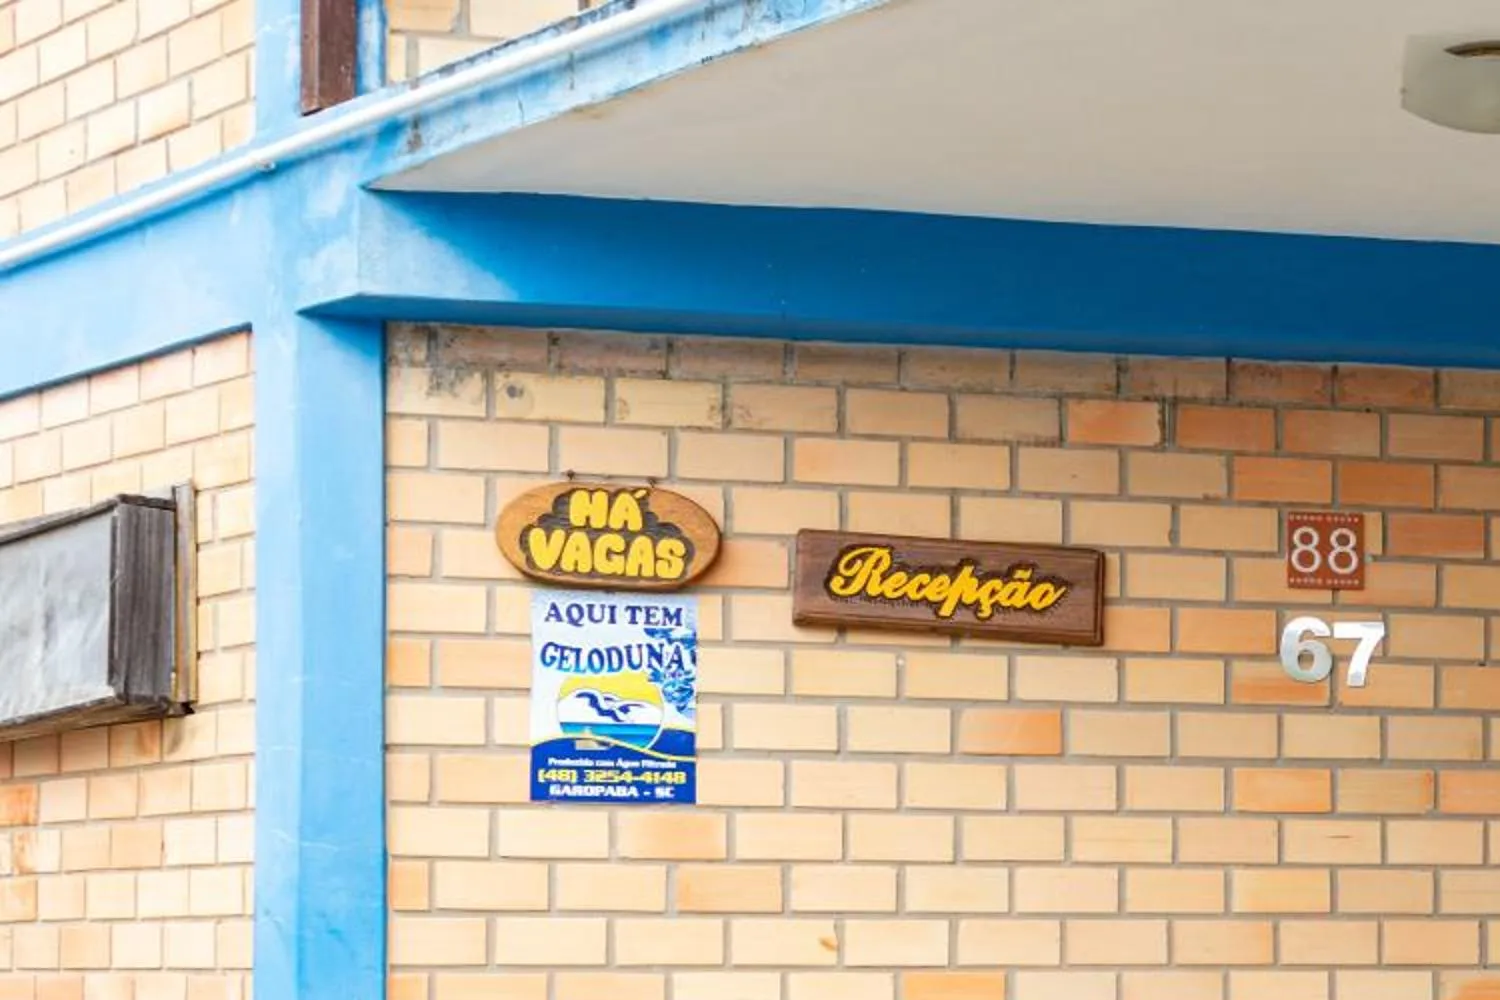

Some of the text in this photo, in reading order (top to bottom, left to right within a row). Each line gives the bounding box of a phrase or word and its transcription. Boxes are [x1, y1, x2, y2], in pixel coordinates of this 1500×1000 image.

[569, 488, 649, 532] HÁ
[528, 528, 687, 579] VAGAS
[1291, 526, 1359, 574] 88
[830, 546, 1069, 618] Recepção
[544, 602, 683, 627] AQUI TEM
[540, 641, 686, 673] GELODUNA
[1281, 616, 1385, 688] 67
[549, 784, 639, 797] GAROPABA
[655, 786, 675, 798] SC
